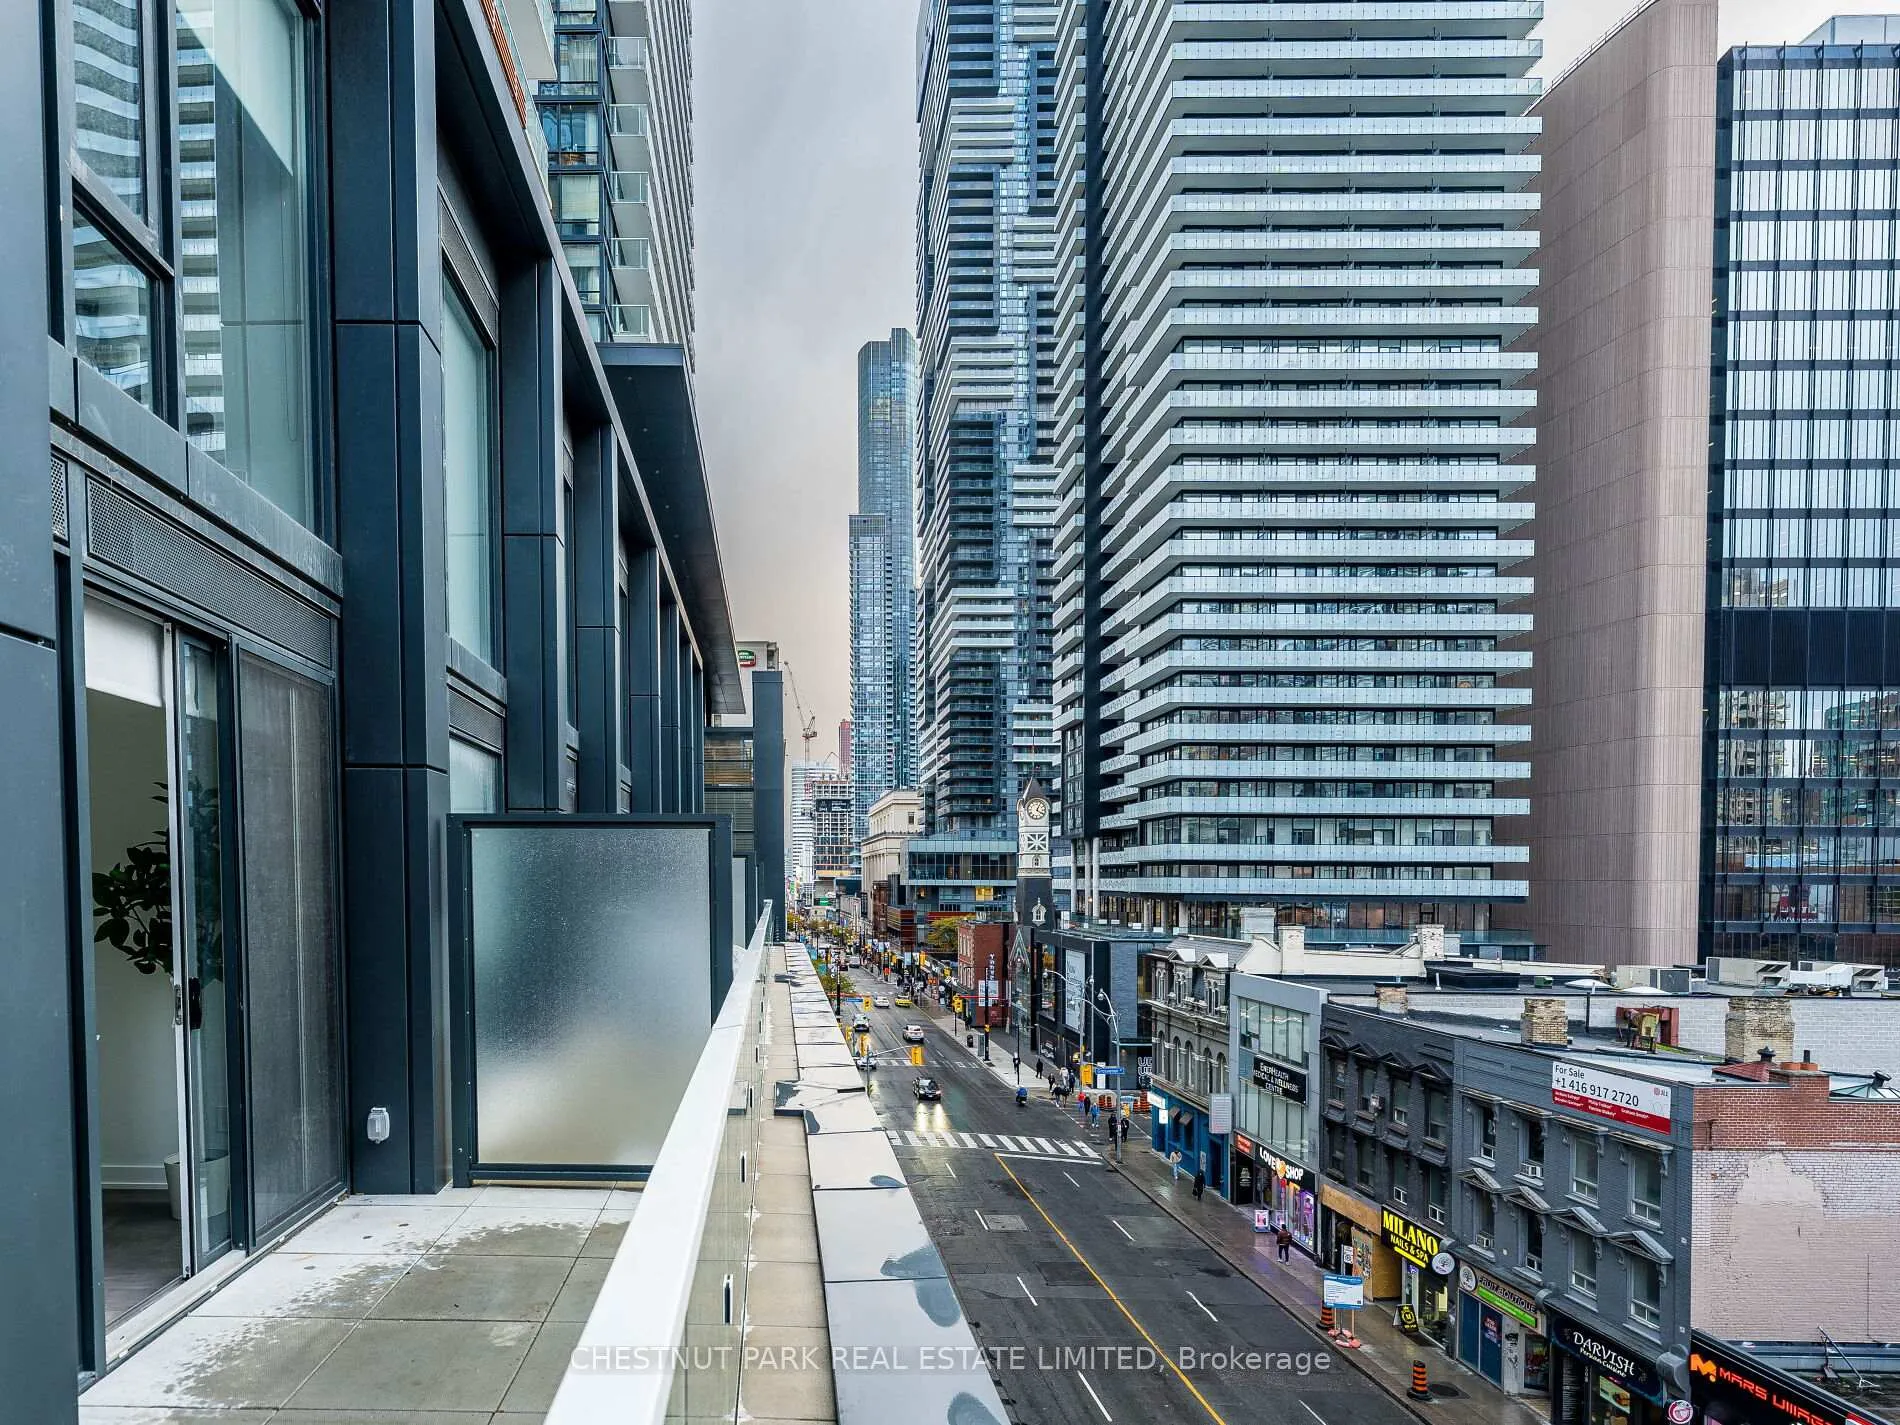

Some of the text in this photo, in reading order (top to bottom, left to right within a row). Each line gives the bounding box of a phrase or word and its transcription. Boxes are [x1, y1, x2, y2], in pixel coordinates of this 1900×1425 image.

[1555, 1064, 1585, 1079] For Sale
[1555, 1077, 1567, 1089] +1
[1568, 1079, 1587, 1094] 416
[1590, 1084, 1609, 1099] 917
[1611, 1089, 1639, 1107] 2720
[1260, 1146, 1303, 1181] LOVE SHOP
[1383, 1210, 1438, 1256] MILANO
[1390, 1234, 1428, 1263] NAILS & SPA
[1498, 1286, 1536, 1313] BOUTIQUE
[1573, 1331, 1635, 1376] DARVISH
[1719, 1367, 1768, 1401] MARS
